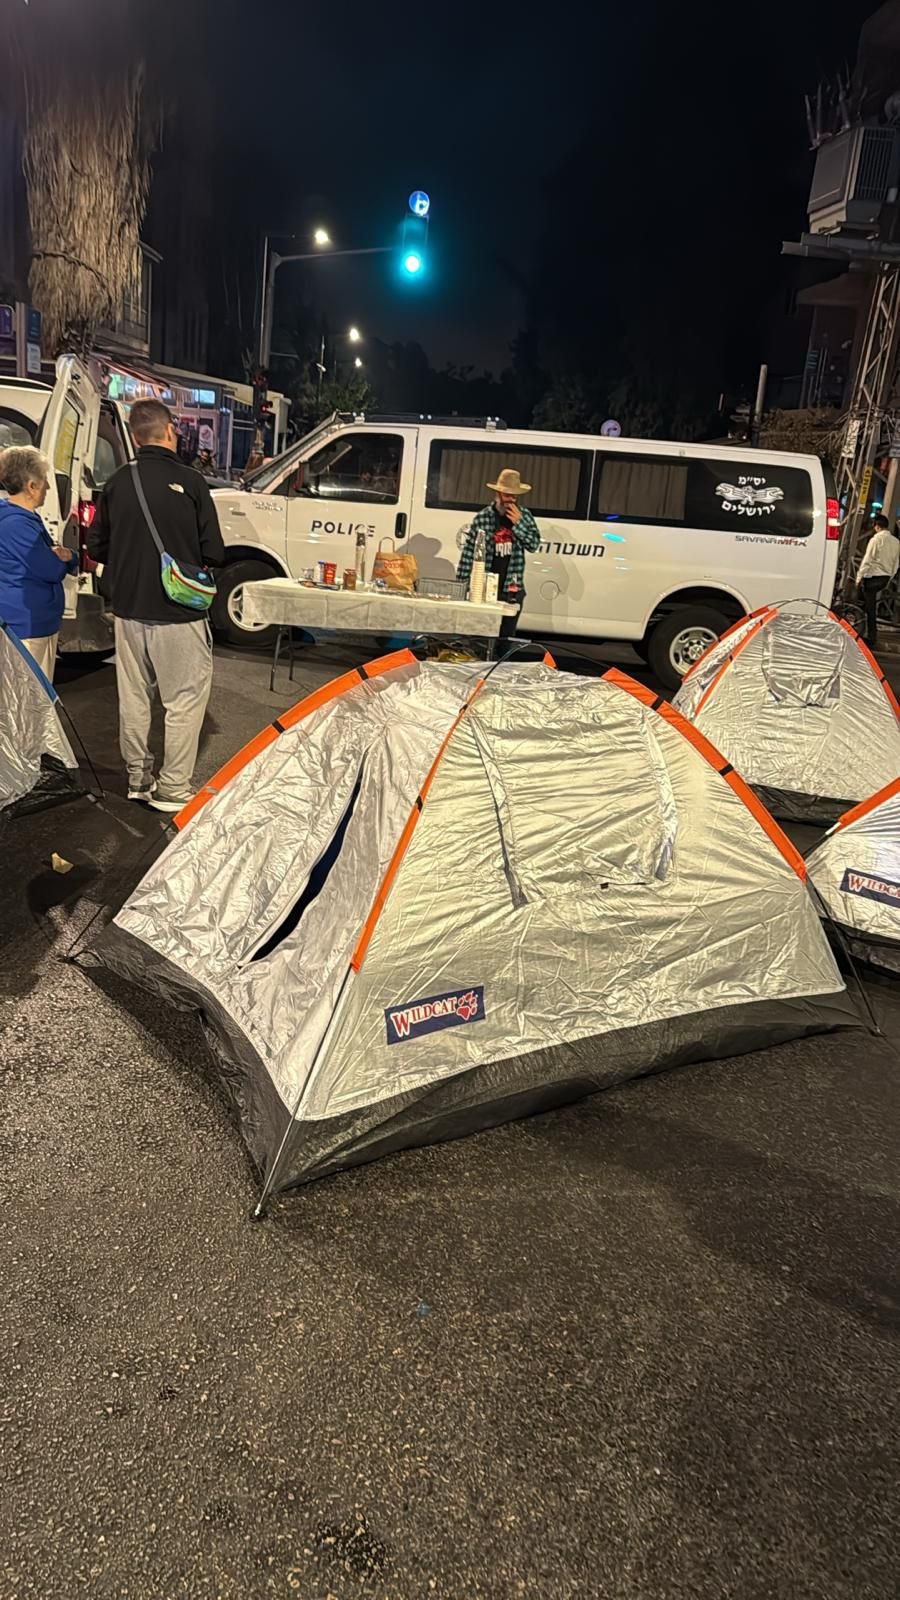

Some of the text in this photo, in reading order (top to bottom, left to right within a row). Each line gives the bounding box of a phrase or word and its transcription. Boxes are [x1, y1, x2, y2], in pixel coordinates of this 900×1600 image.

[721, 501, 776, 516] ירושלים
[539, 542, 605, 557] משטרה
[390, 996, 457, 1037] WILDCAT
